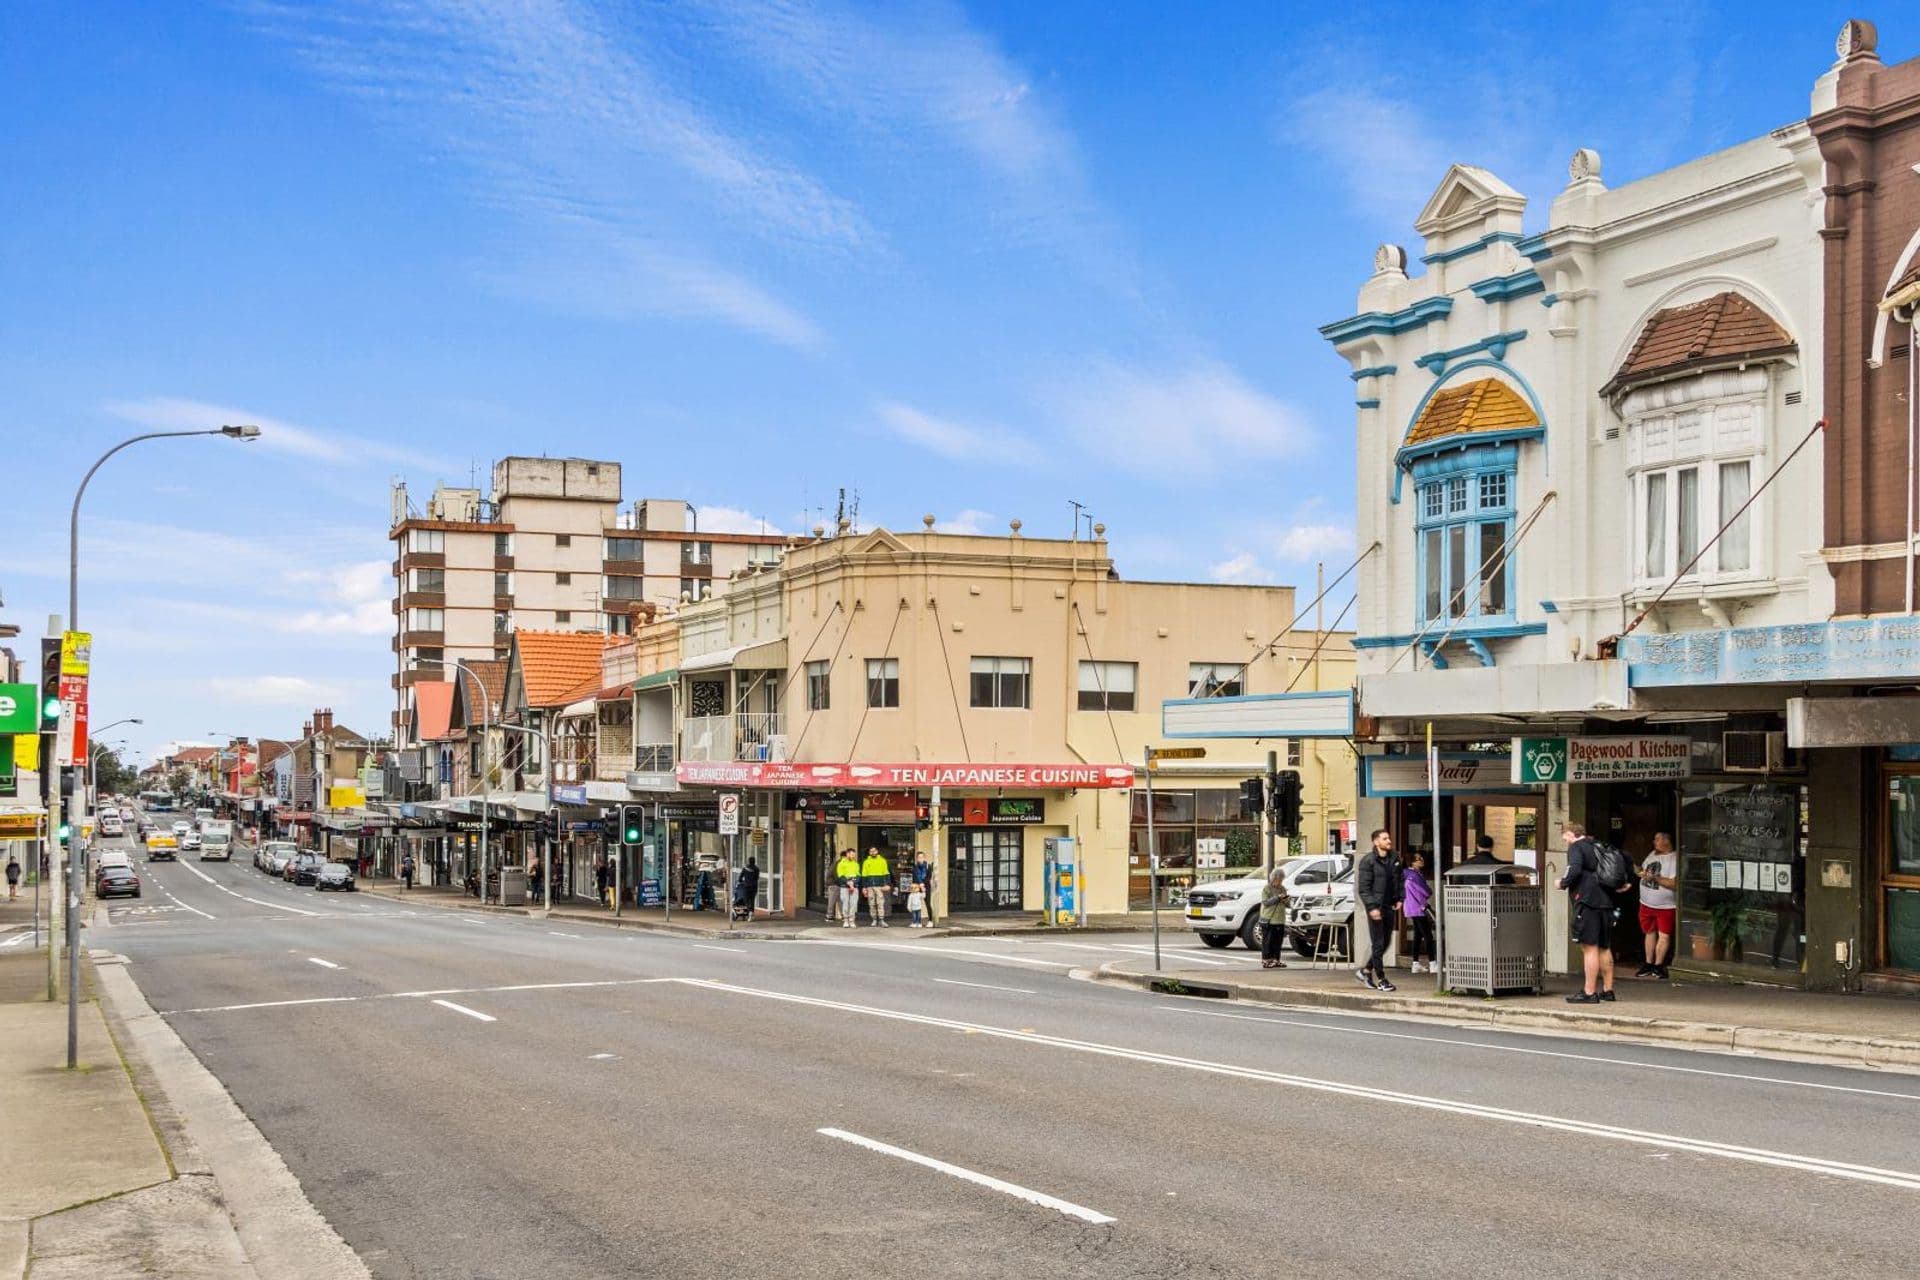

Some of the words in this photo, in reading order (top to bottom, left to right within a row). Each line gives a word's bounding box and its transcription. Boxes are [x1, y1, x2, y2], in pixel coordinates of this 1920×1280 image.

[1571, 741, 1633, 763] Pagewood
[1639, 740, 1687, 758] Kitchen
[1577, 762, 1609, 770] Eat-in
[1612, 761, 1621, 769] &
[1624, 760, 1682, 770] Take-away
[891, 769, 926, 782] TEN
[931, 769, 1025, 783] JAPANESE
[1030, 769, 1099, 782] CUISINE
[1585, 771, 1609, 779] Home
[1612, 770, 1646, 779] Delivery
